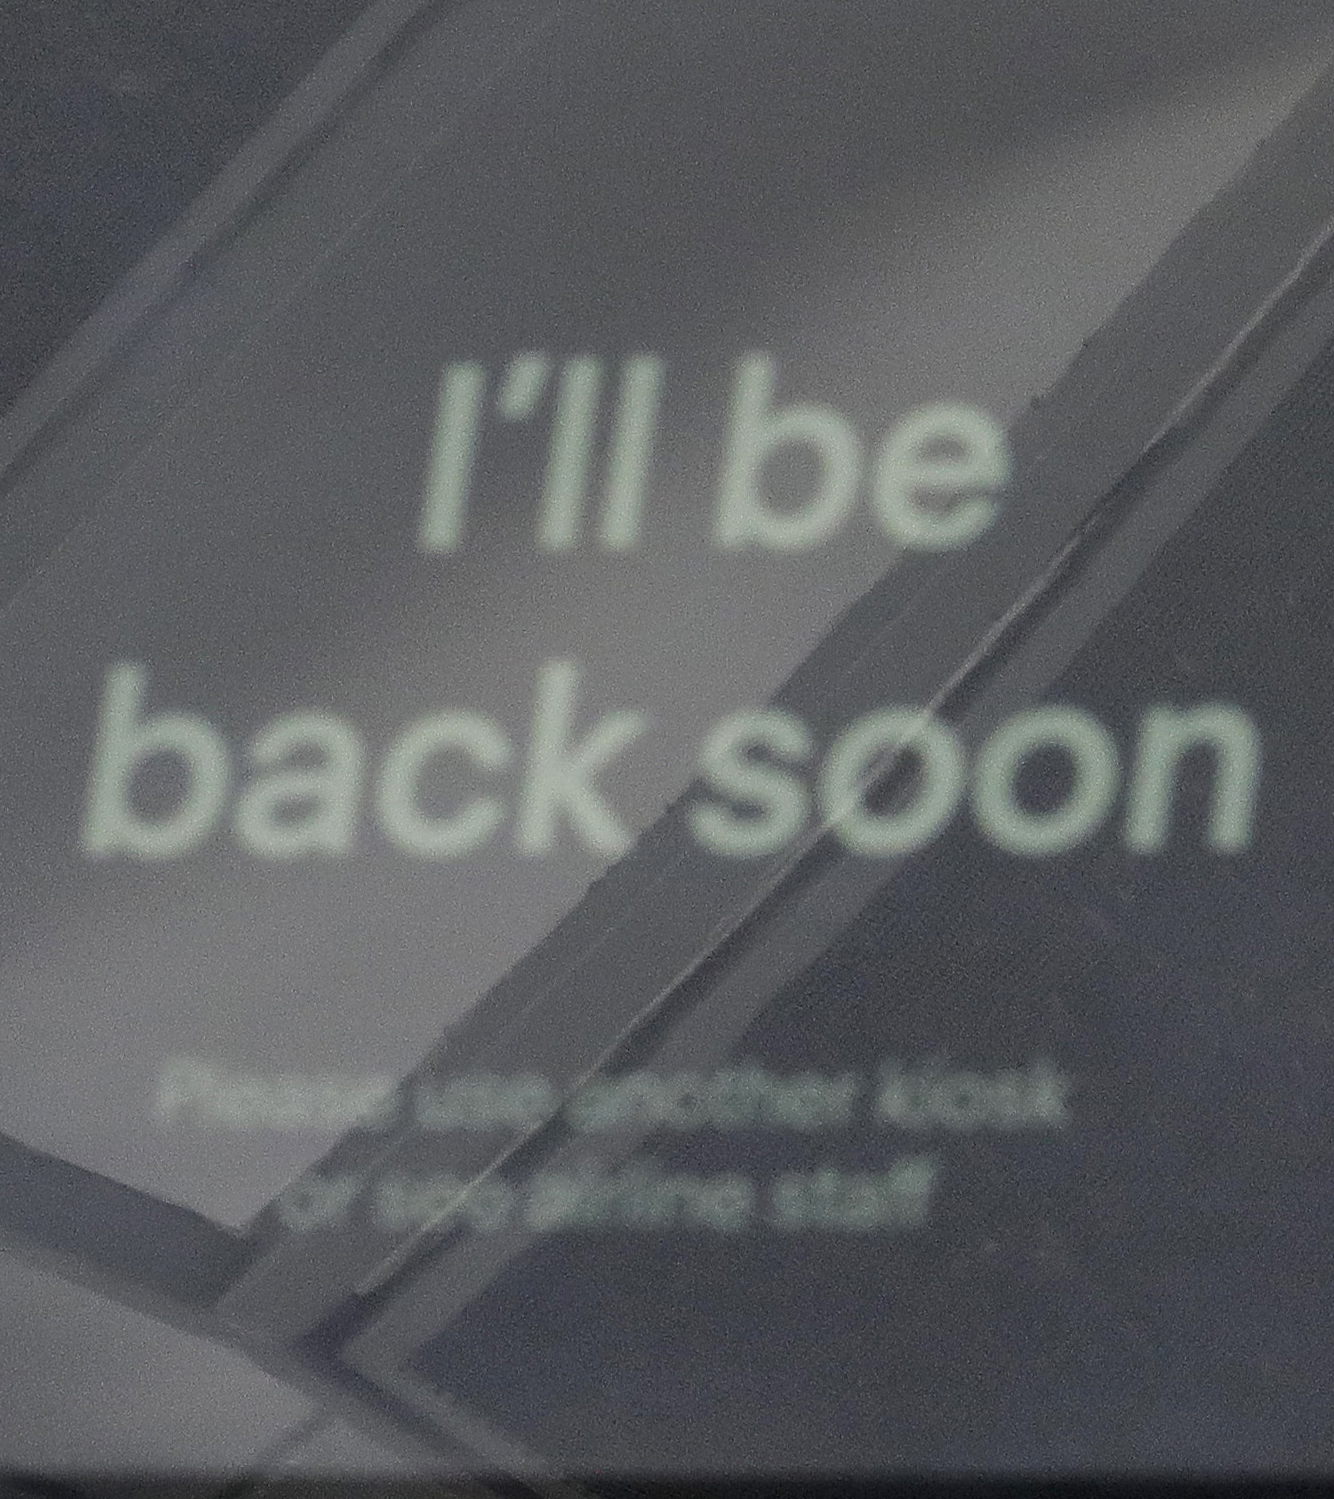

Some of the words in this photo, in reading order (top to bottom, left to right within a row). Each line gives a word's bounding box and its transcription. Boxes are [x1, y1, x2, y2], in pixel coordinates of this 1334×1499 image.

[715, 351, 1014, 555] be
[82, 659, 650, 862] back
[686, 699, 1265, 860] soon
